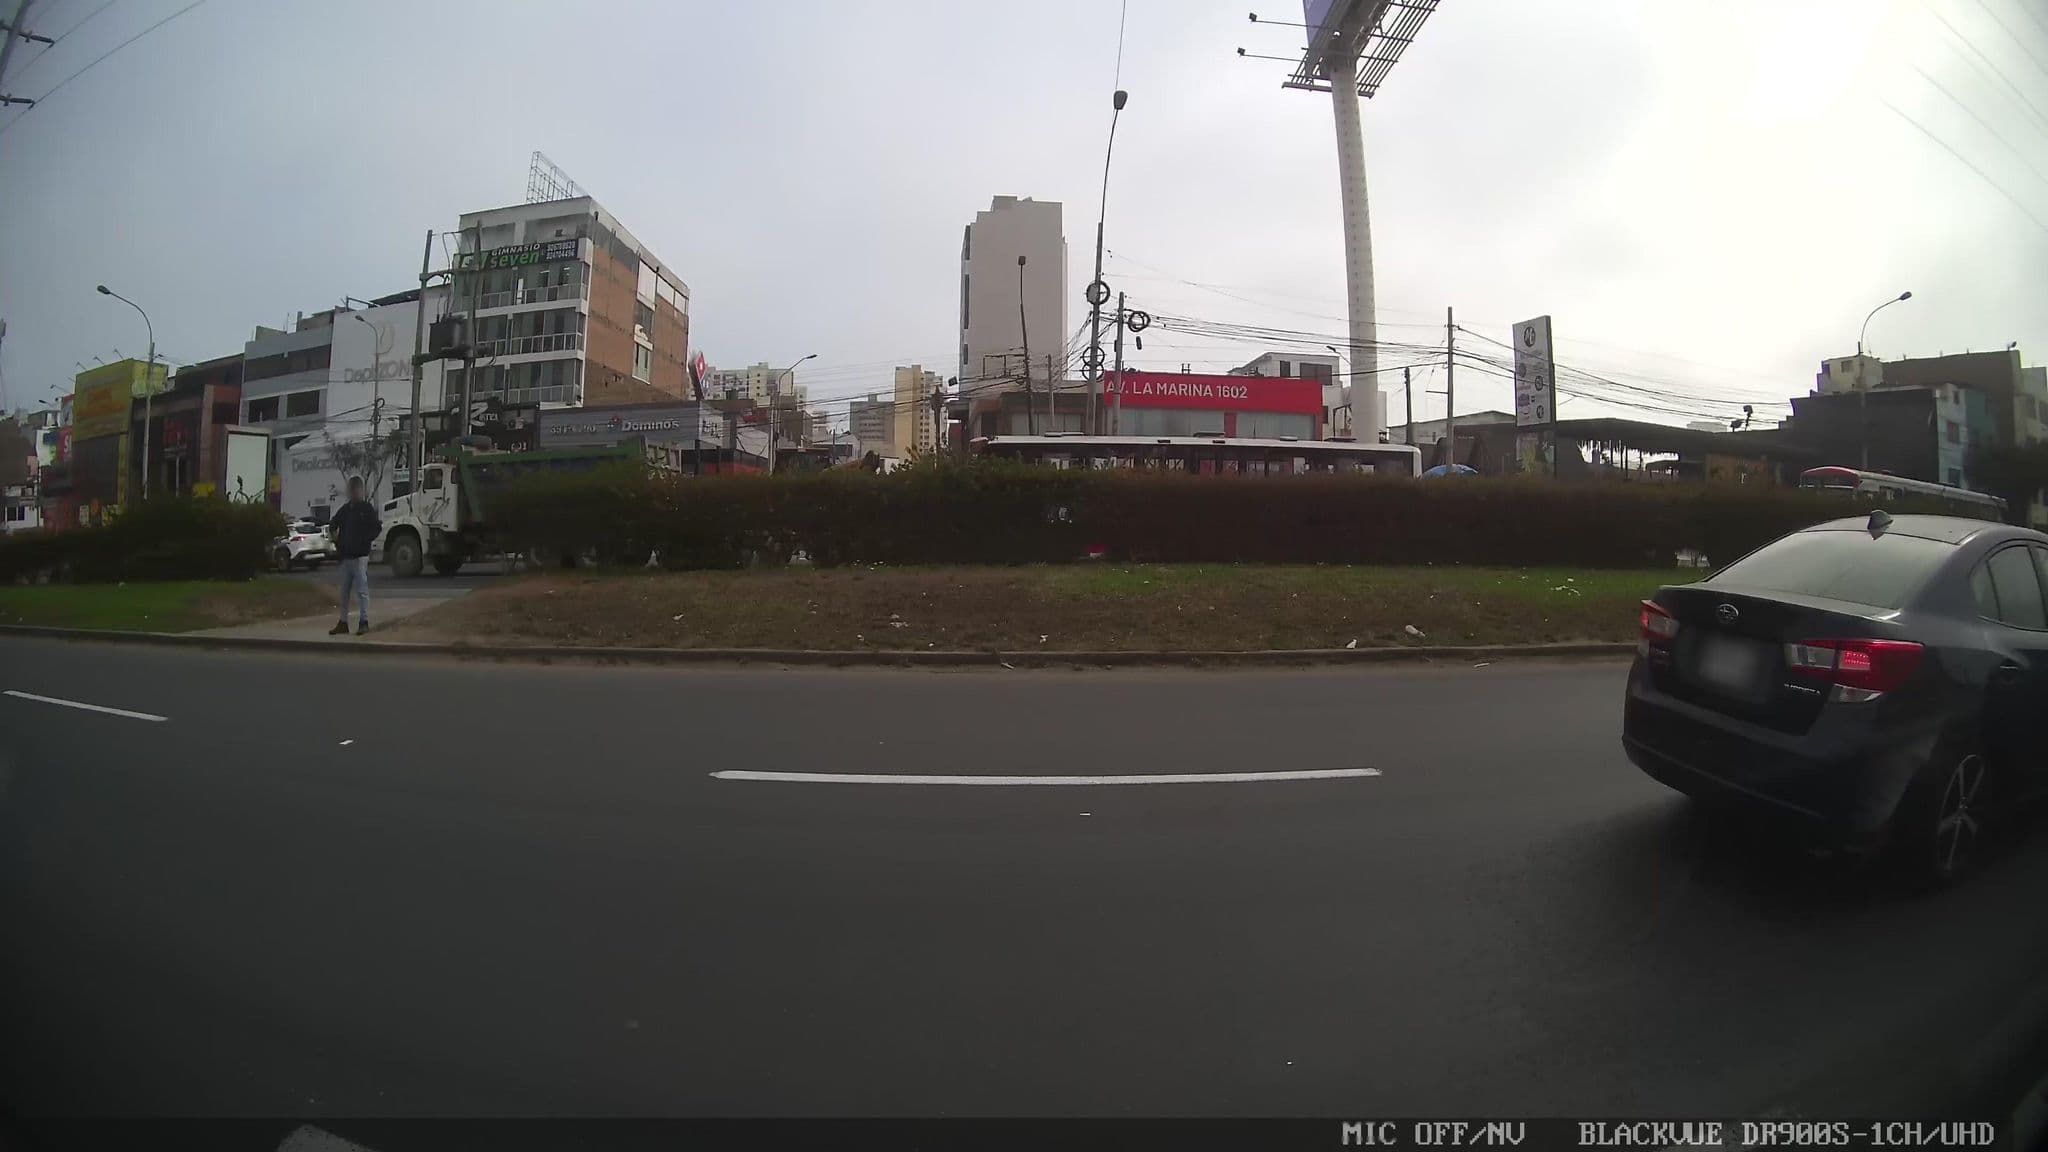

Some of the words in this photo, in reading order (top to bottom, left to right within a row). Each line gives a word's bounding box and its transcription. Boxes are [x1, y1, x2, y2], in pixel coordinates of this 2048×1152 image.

[492, 243, 541, 256] GIMNASIO
[1133, 381, 1153, 395] LA
[1156, 382, 1214, 397] MARINA
[1217, 385, 1249, 399] 1602
